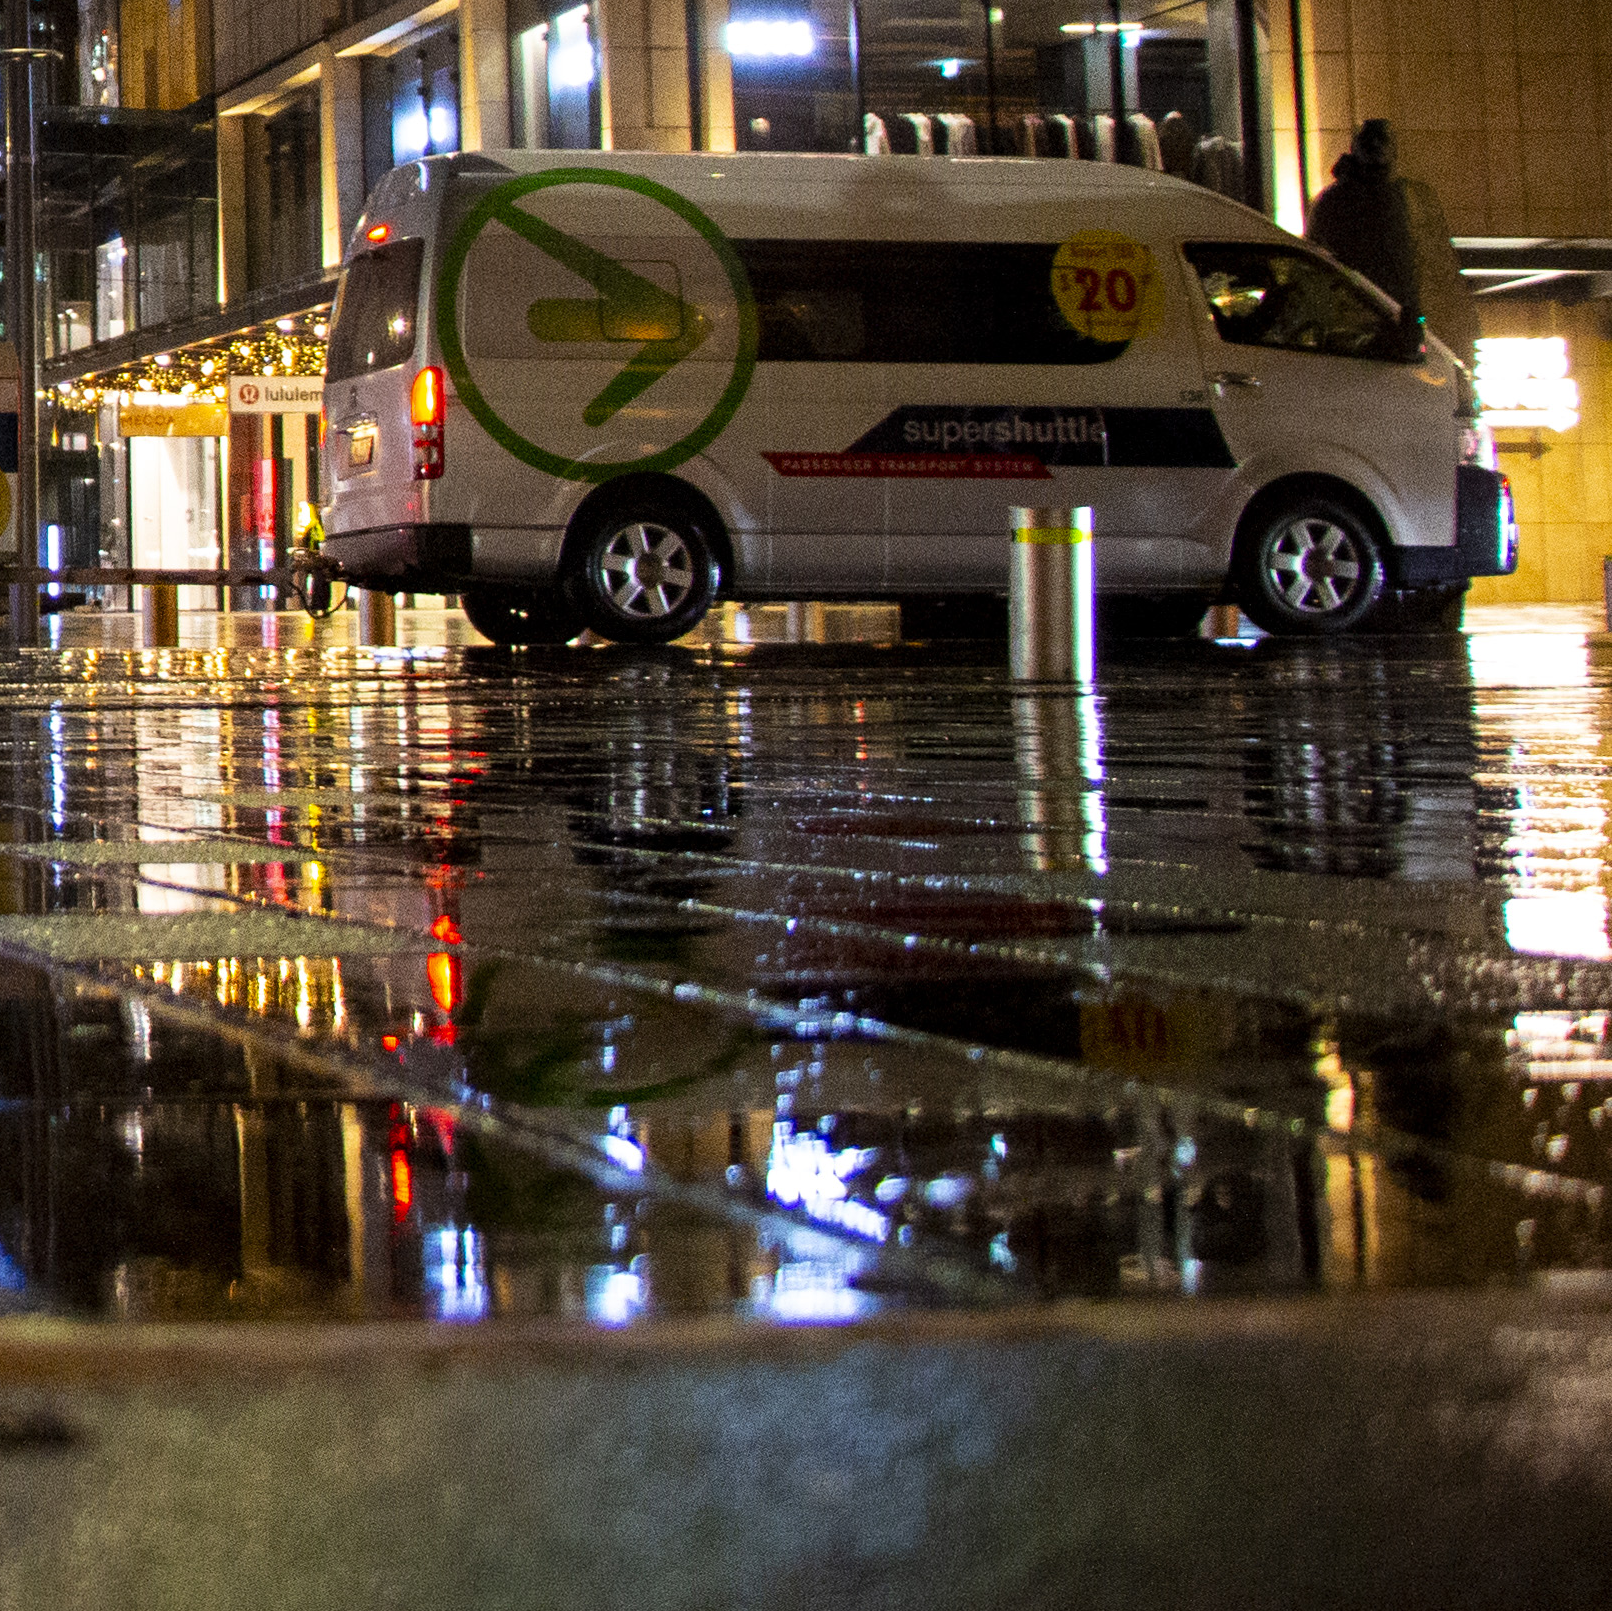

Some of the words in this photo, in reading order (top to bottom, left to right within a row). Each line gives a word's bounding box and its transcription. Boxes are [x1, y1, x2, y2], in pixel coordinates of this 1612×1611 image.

[264, 386, 324, 402] lululem
[121, 415, 175, 427] MECCA
[902, 414, 1107, 450] supershuttle
[780, 458, 873, 472] PASSENGER
[878, 459, 967, 473] TRANSPORT
